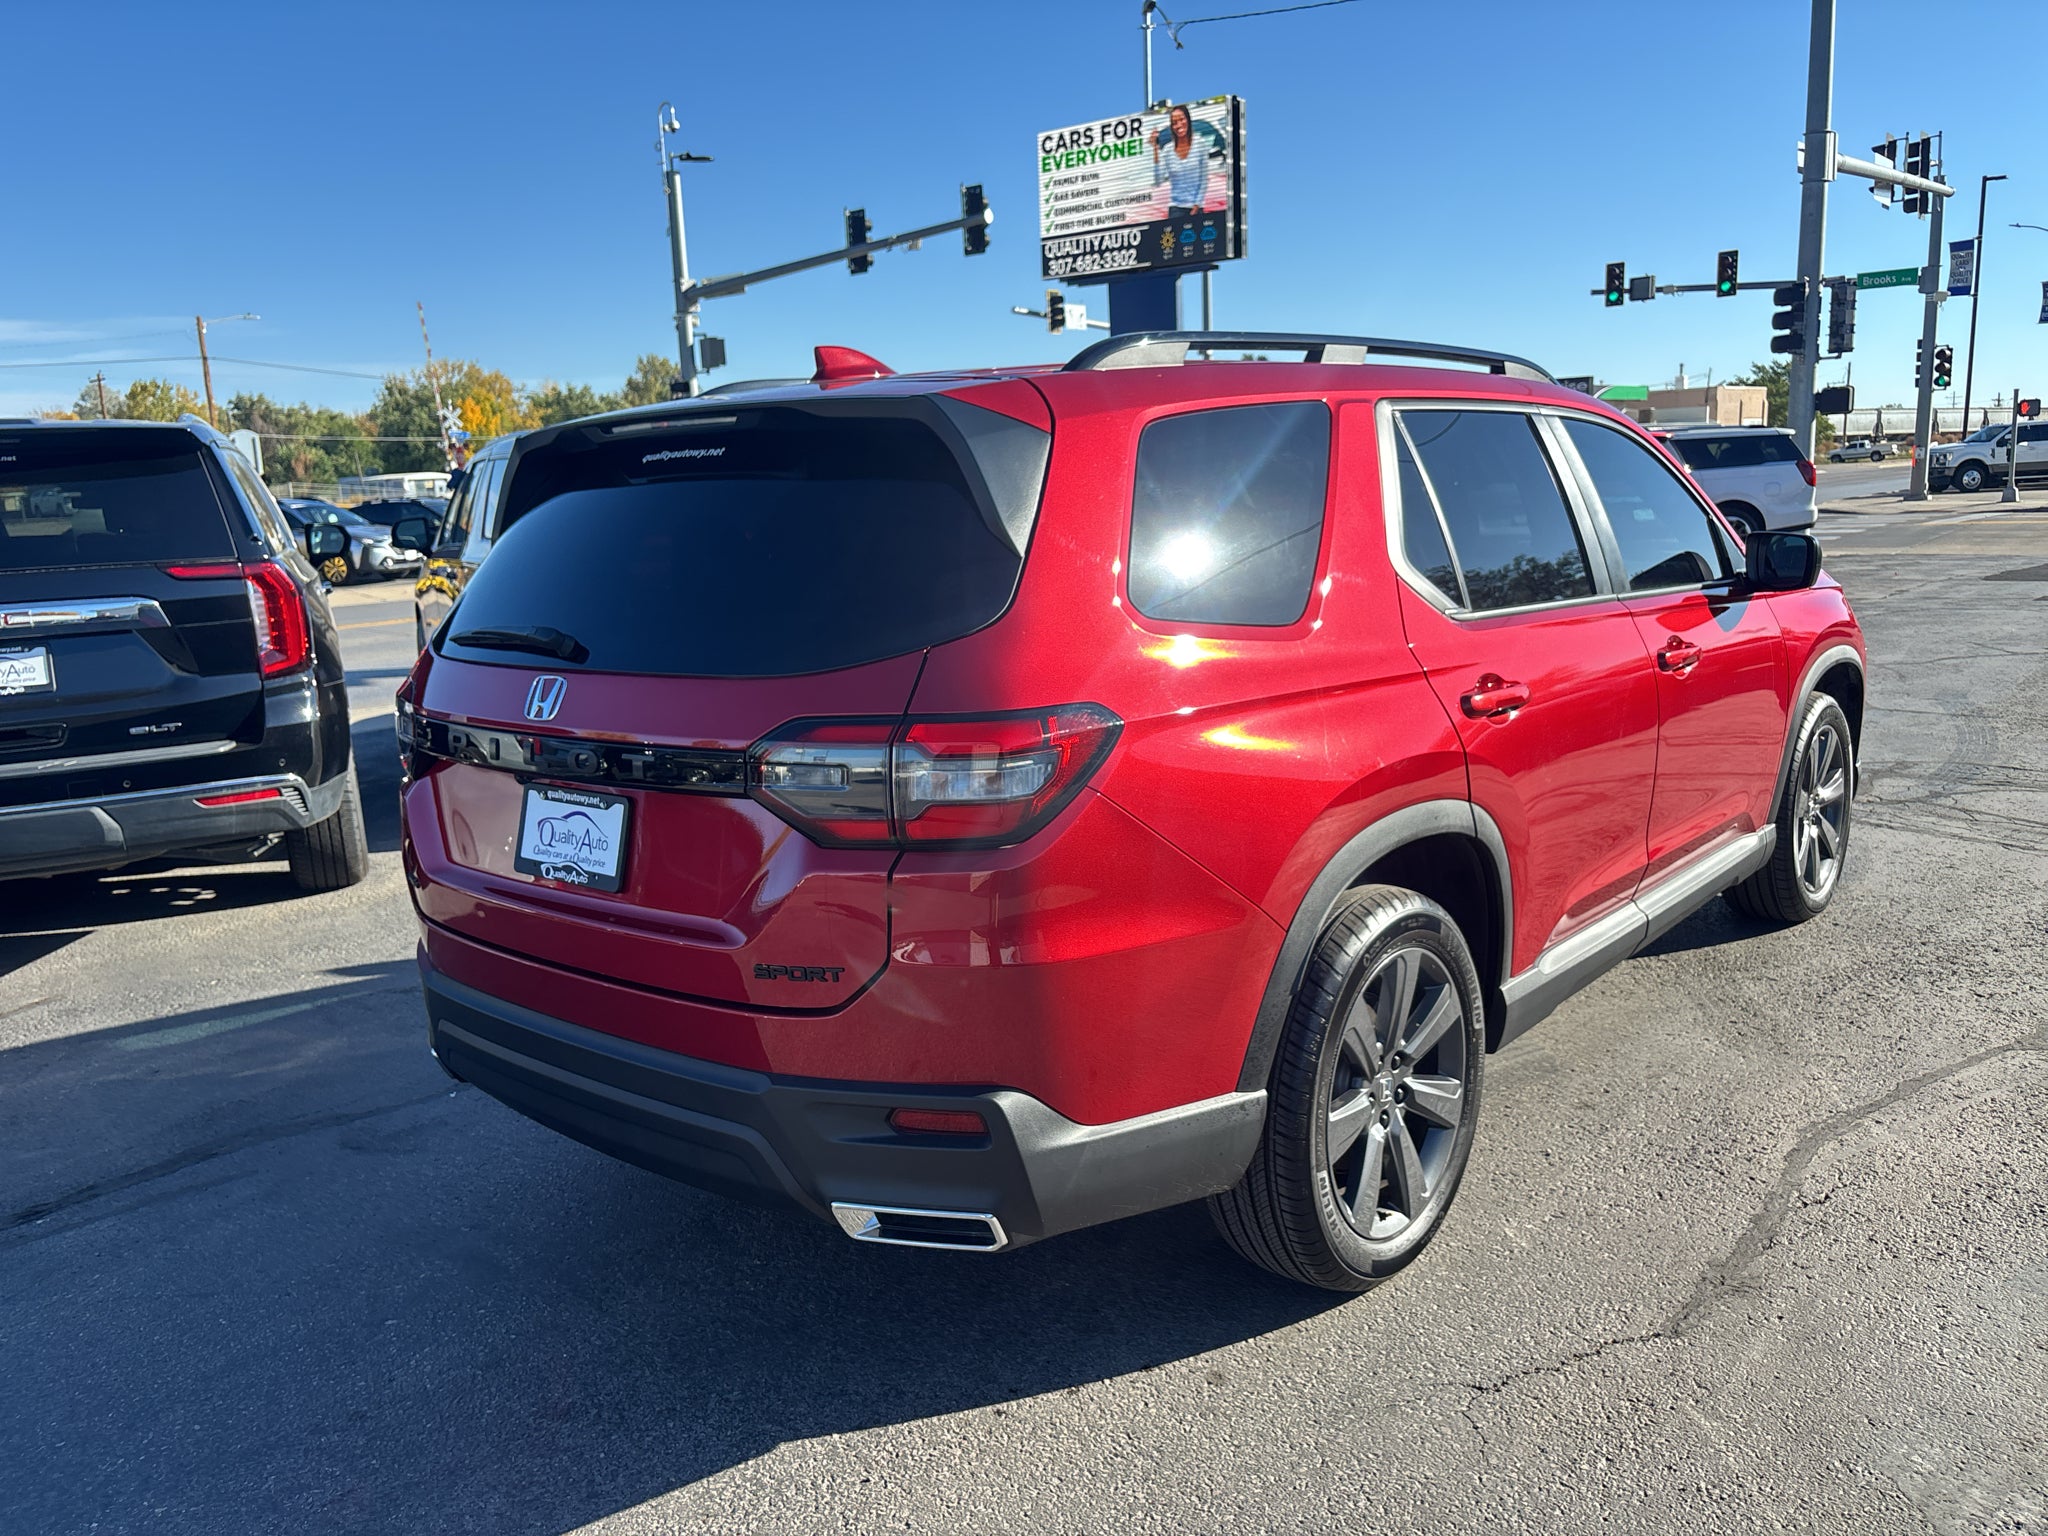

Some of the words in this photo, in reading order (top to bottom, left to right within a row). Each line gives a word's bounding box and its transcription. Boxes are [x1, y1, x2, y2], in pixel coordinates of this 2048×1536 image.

[1042, 127, 1094, 154] CARS
[1101, 118, 1142, 143] FOR
[1042, 138, 1144, 172] EVERYONE!
[1054, 201, 1103, 217] COMMERCIAL
[1104, 193, 1152, 209] CUSTOMERS
[1862, 275, 1897, 286] Brooks
[642, 447, 726, 464] qualityautowy.net
[547, 790, 600, 805] qualityautowy.net
[533, 845, 551, 858] Quality
[573, 853, 592, 866] Quality
[592, 859, 606, 868] price
[754, 964, 845, 983] SPORT
